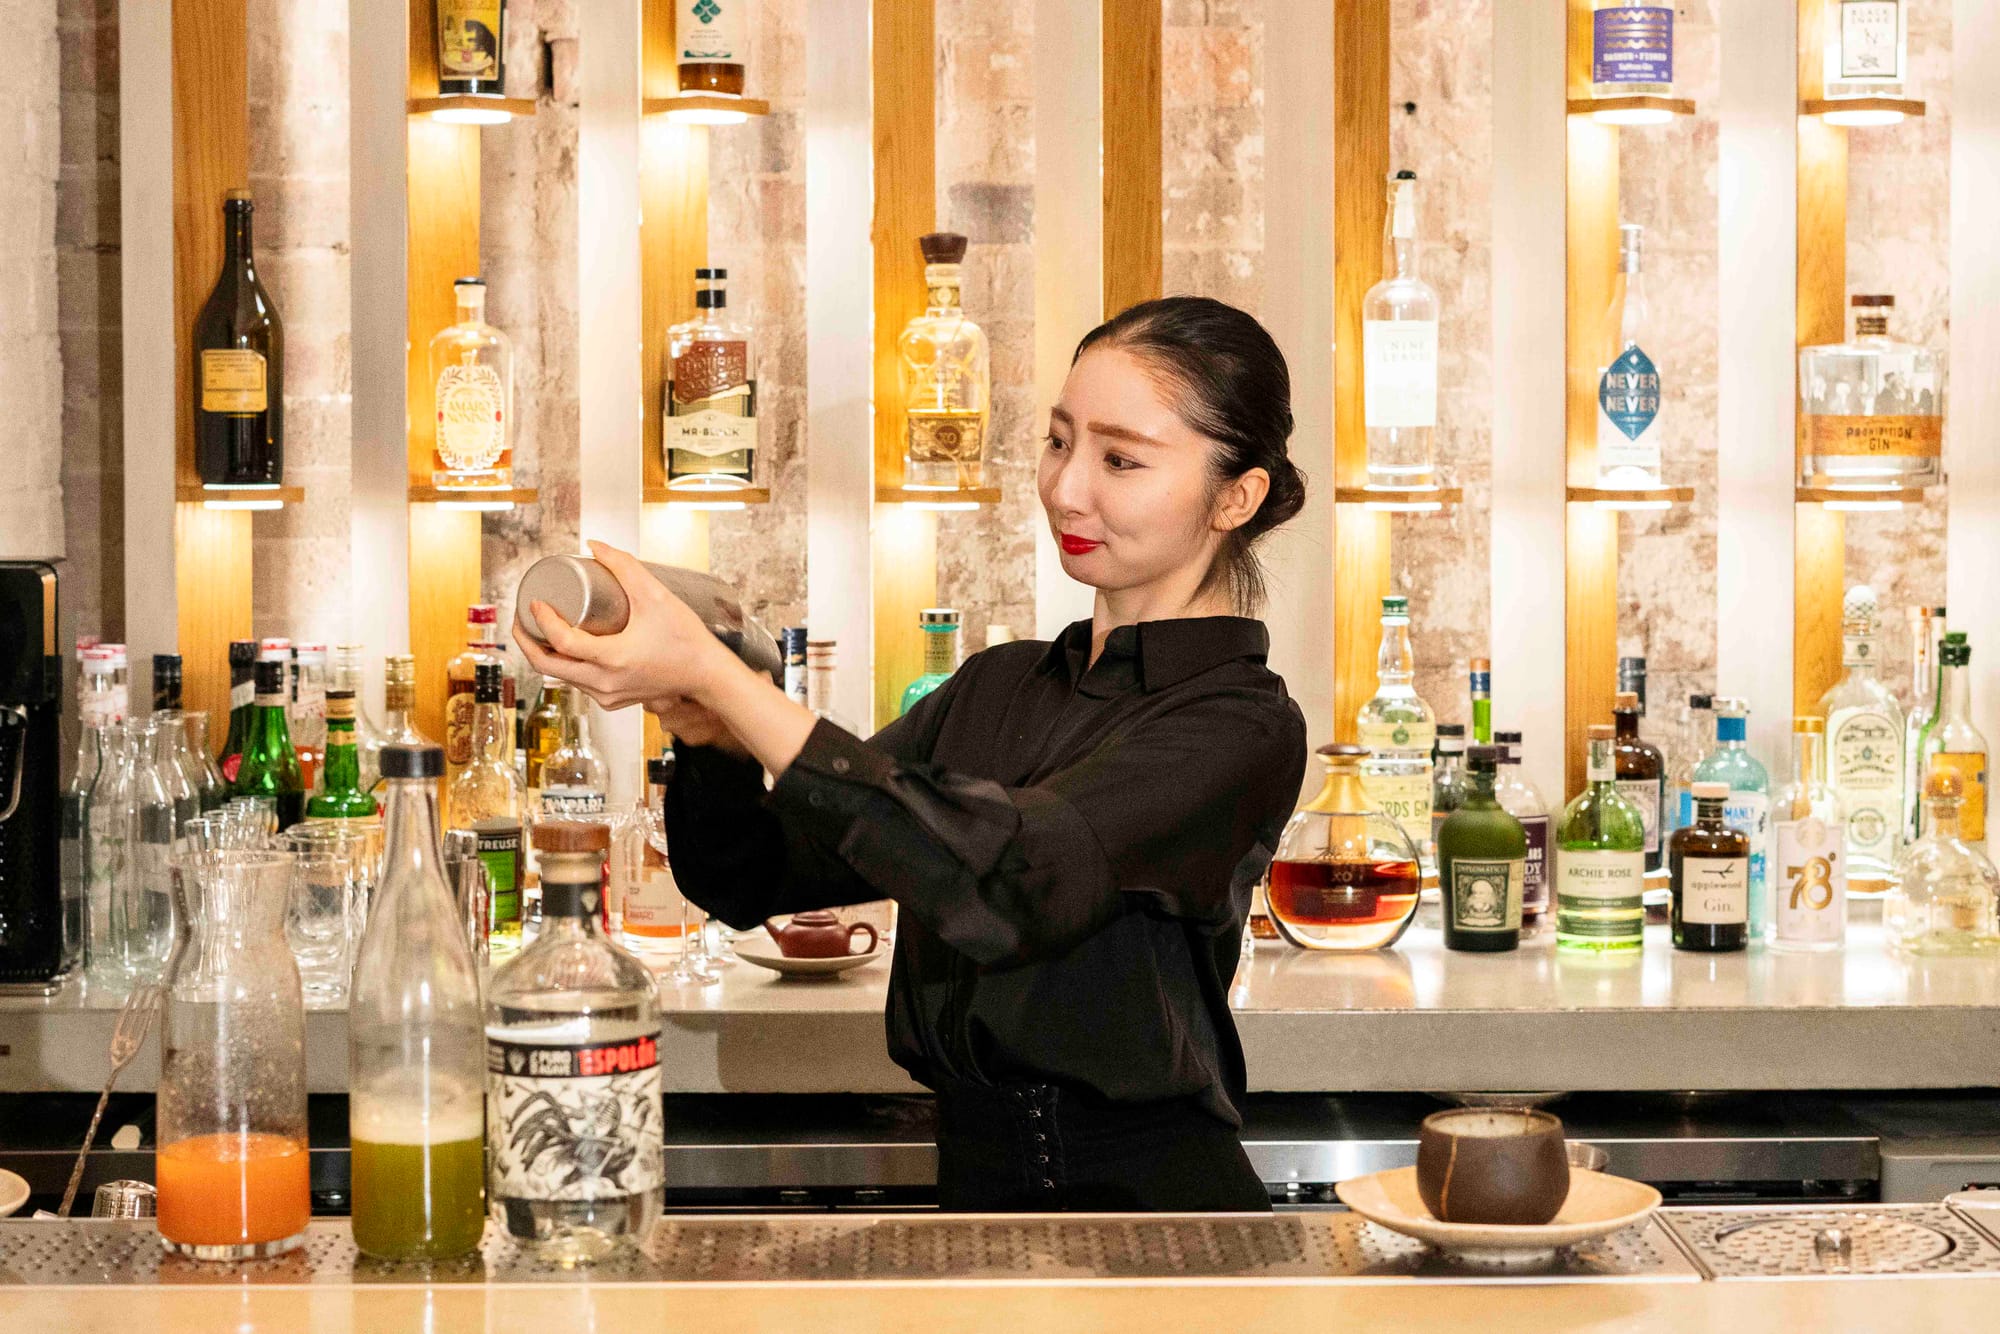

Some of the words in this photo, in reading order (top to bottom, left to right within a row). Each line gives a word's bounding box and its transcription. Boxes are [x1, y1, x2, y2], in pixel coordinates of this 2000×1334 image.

[1606, 372, 1657, 389] NEVER
[1605, 396, 1656, 412] NEVER
[1869, 438, 1890, 451] GIN
[1568, 867, 1604, 878] ARCHIE
[1608, 868, 1633, 878] ROSE
